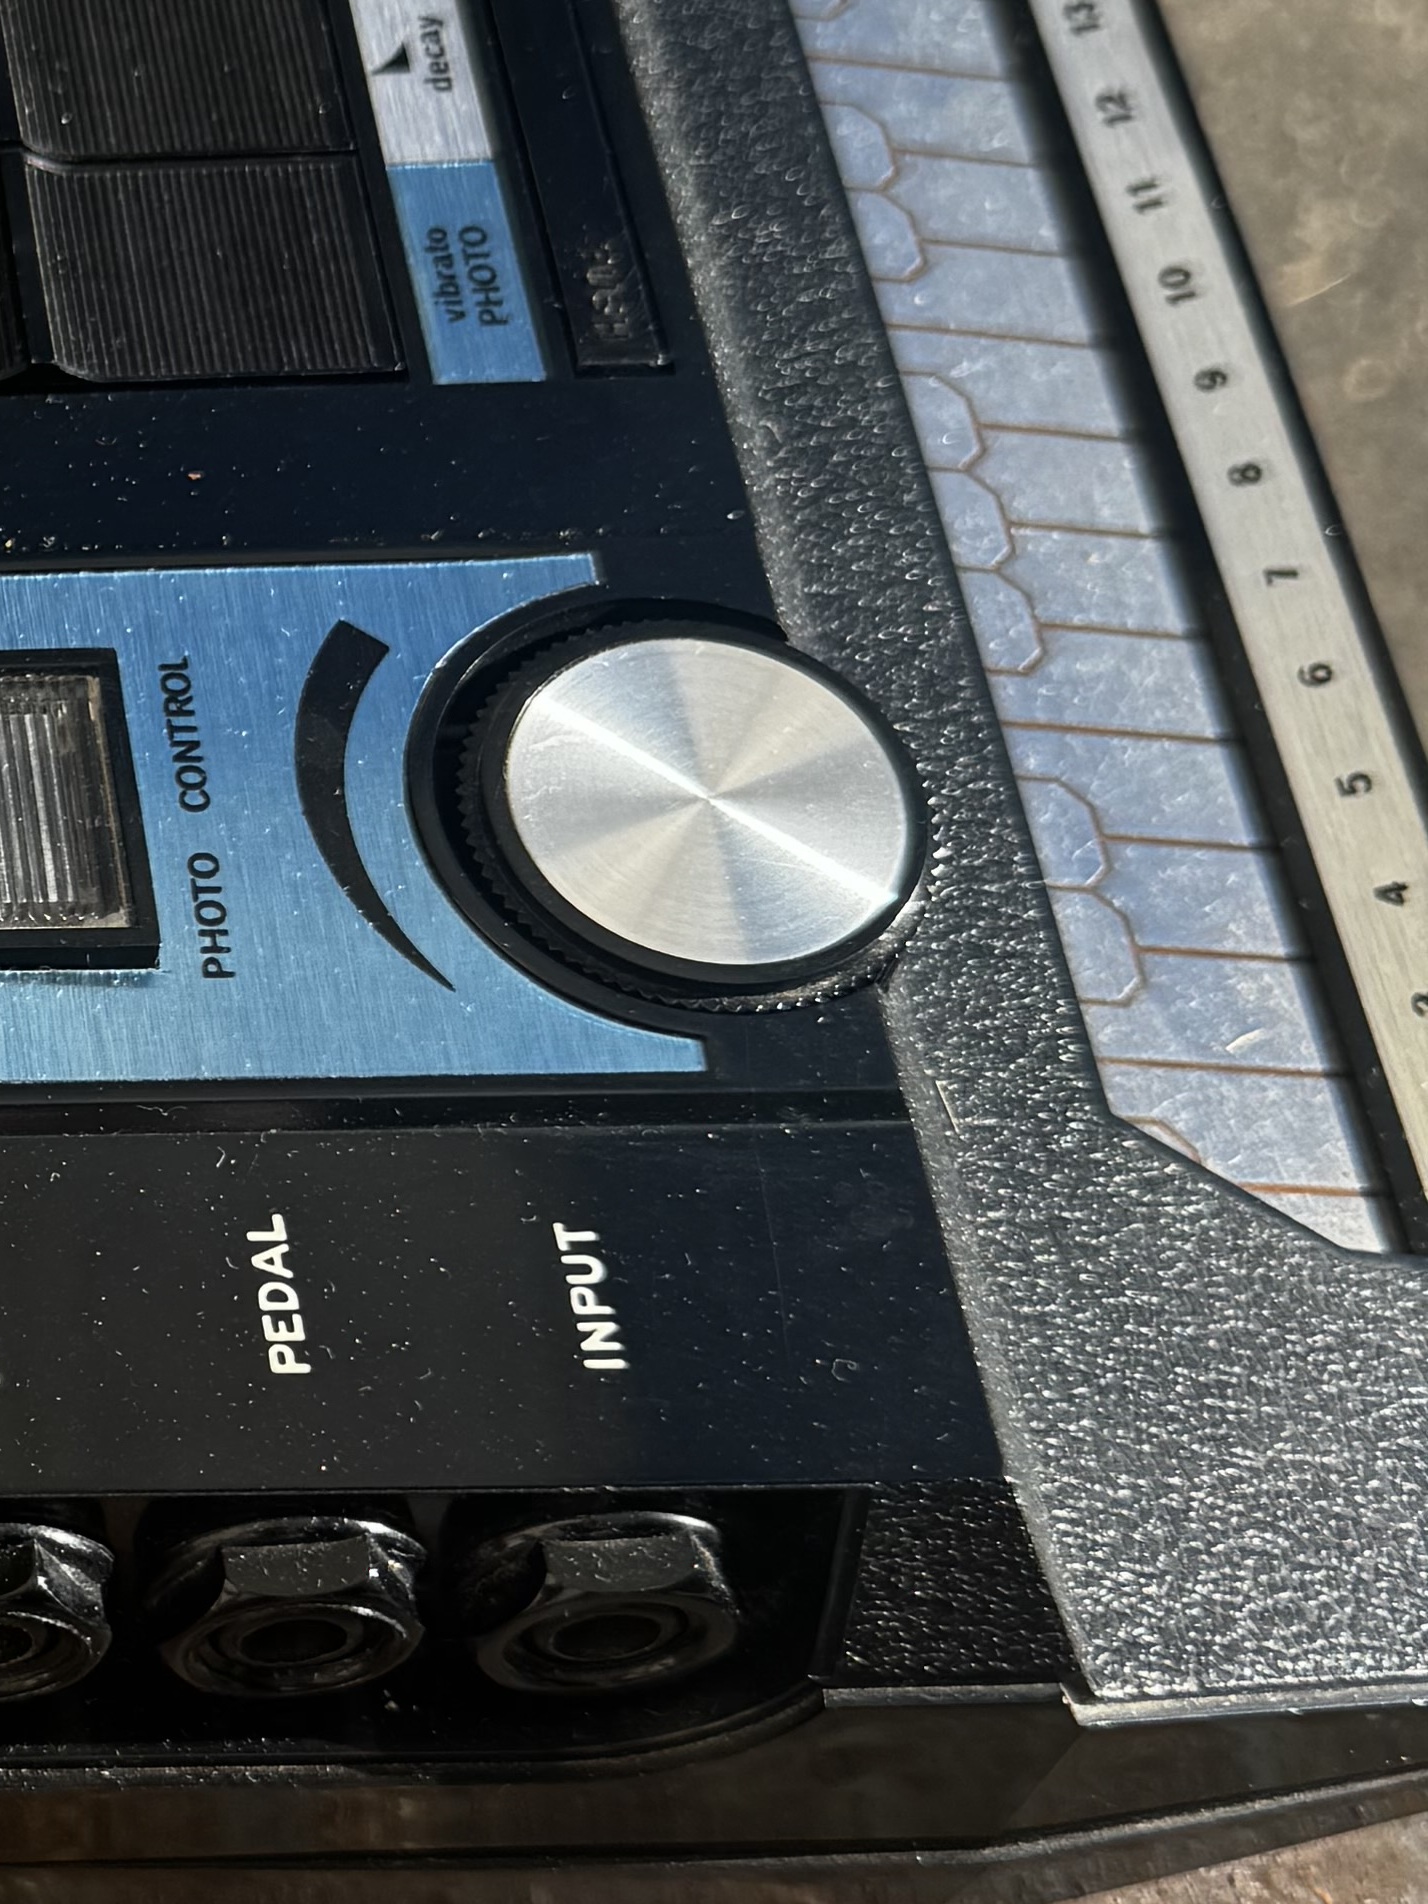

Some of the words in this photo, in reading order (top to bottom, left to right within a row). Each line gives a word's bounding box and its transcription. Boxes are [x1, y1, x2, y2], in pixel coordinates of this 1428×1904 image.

[417, 15, 453, 93] decay
[1095, 87, 1135, 128] 12
[1126, 177, 1166, 214] 11
[424, 226, 467, 325] vibrato
[458, 224, 511, 328] PHOTO
[1158, 265, 1198, 306] 10
[1194, 367, 1228, 393] 9
[1227, 461, 1263, 487] 8
[1262, 566, 1300, 587] 7
[1297, 662, 1335, 688] 6
[158, 654, 212, 814] CONTROL
[1335, 770, 1373, 797] 5
[1373, 881, 1409, 907] 4
[186, 851, 237, 980] PHOTO
[246, 1212, 313, 1375] PEDAL
[553, 1221, 631, 1371] INPUT
